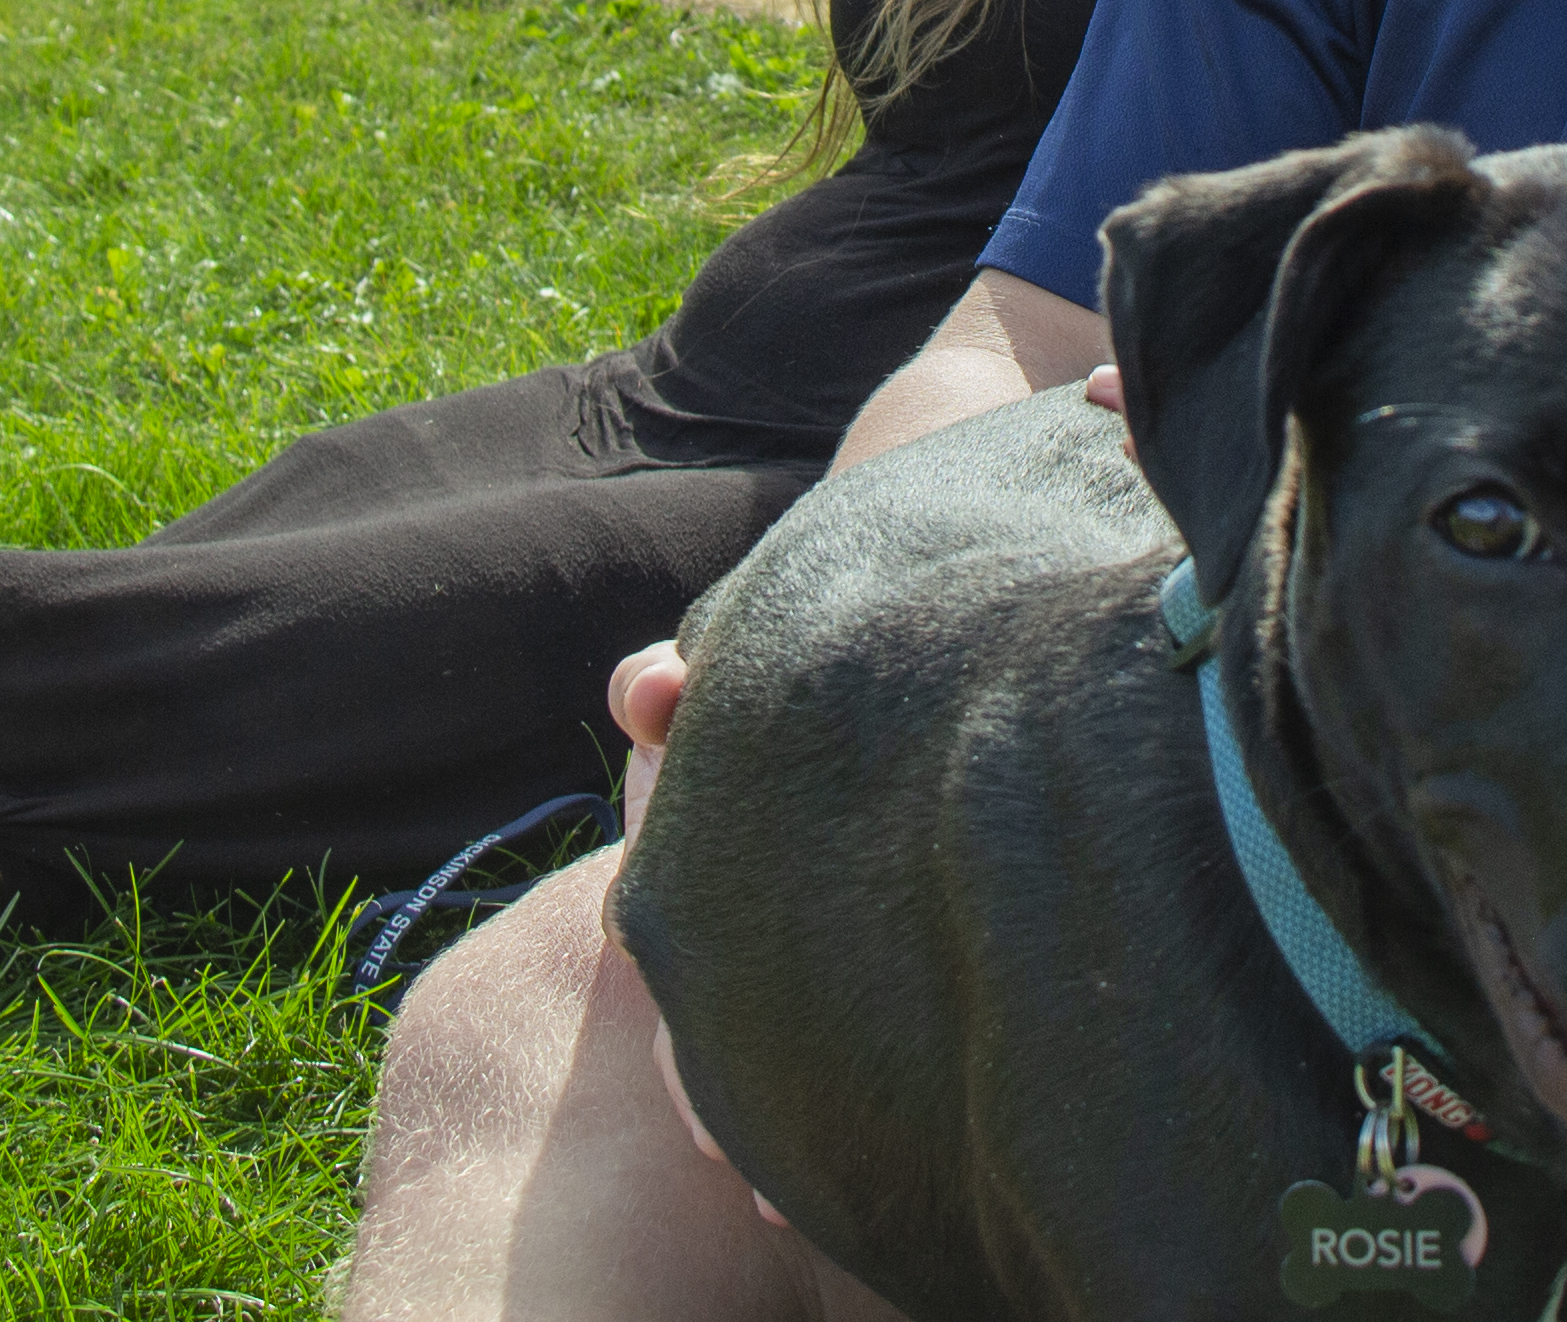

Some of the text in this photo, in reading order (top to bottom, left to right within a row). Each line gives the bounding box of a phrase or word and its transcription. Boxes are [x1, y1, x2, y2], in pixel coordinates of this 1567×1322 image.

[360, 833, 503, 980] DICKINSON STATE
[1311, 1227, 1443, 1269] ROSIE
